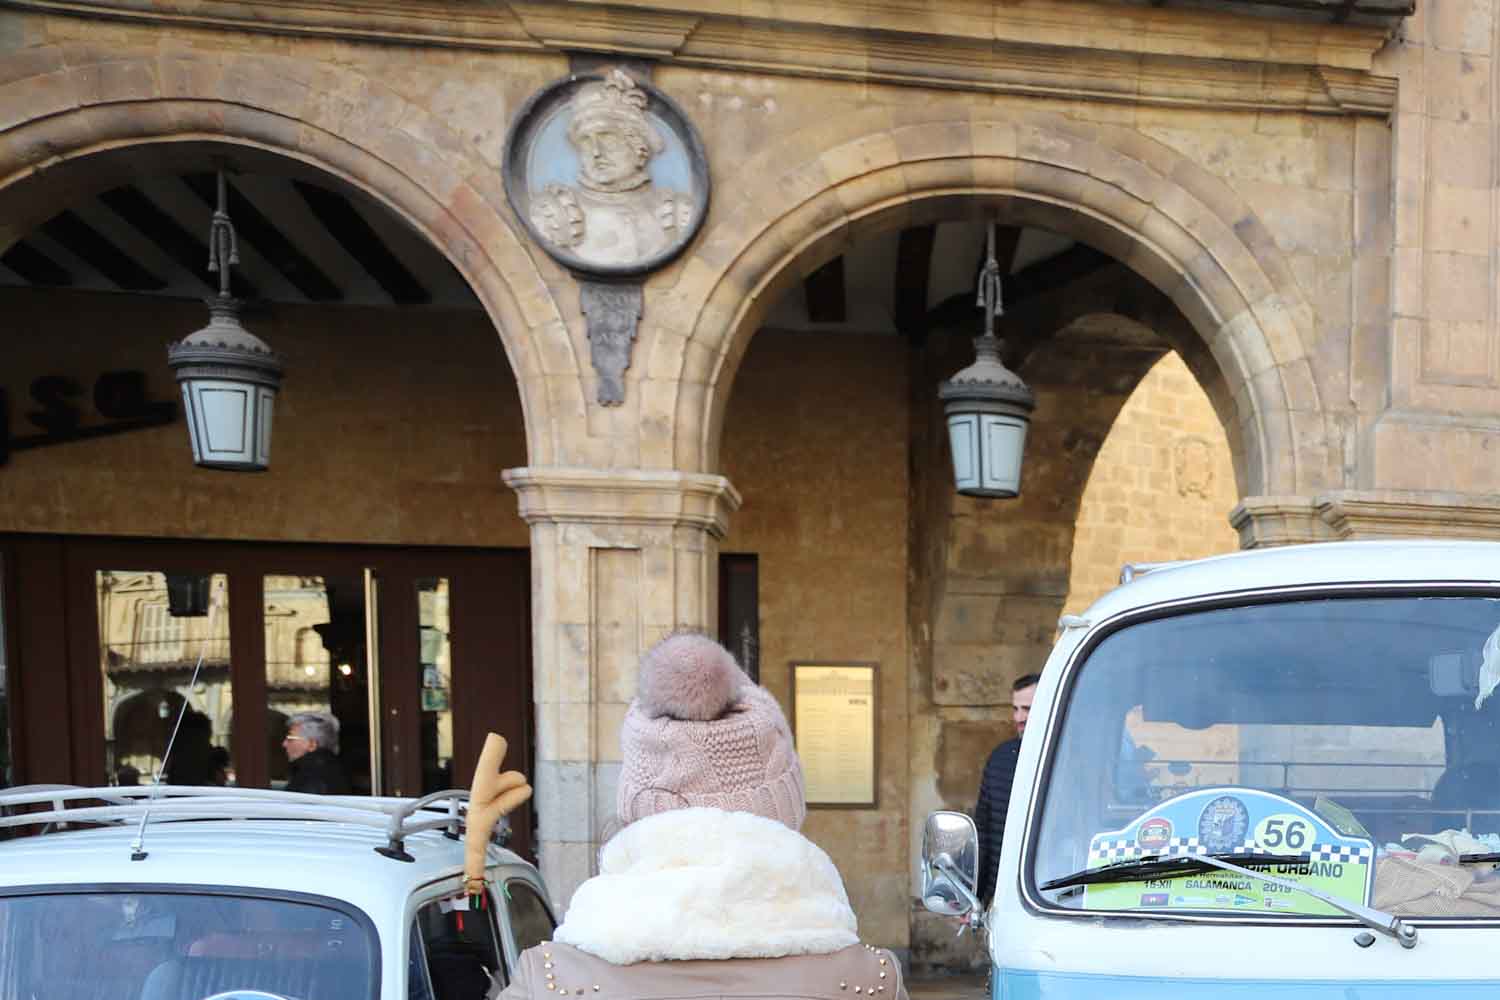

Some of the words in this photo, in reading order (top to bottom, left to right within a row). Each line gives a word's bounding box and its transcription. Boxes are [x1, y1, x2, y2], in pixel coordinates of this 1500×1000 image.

[1262, 819, 1307, 850] 56
[1279, 860, 1343, 878] URBANO
[1184, 879, 1253, 891] SALAMANCA
